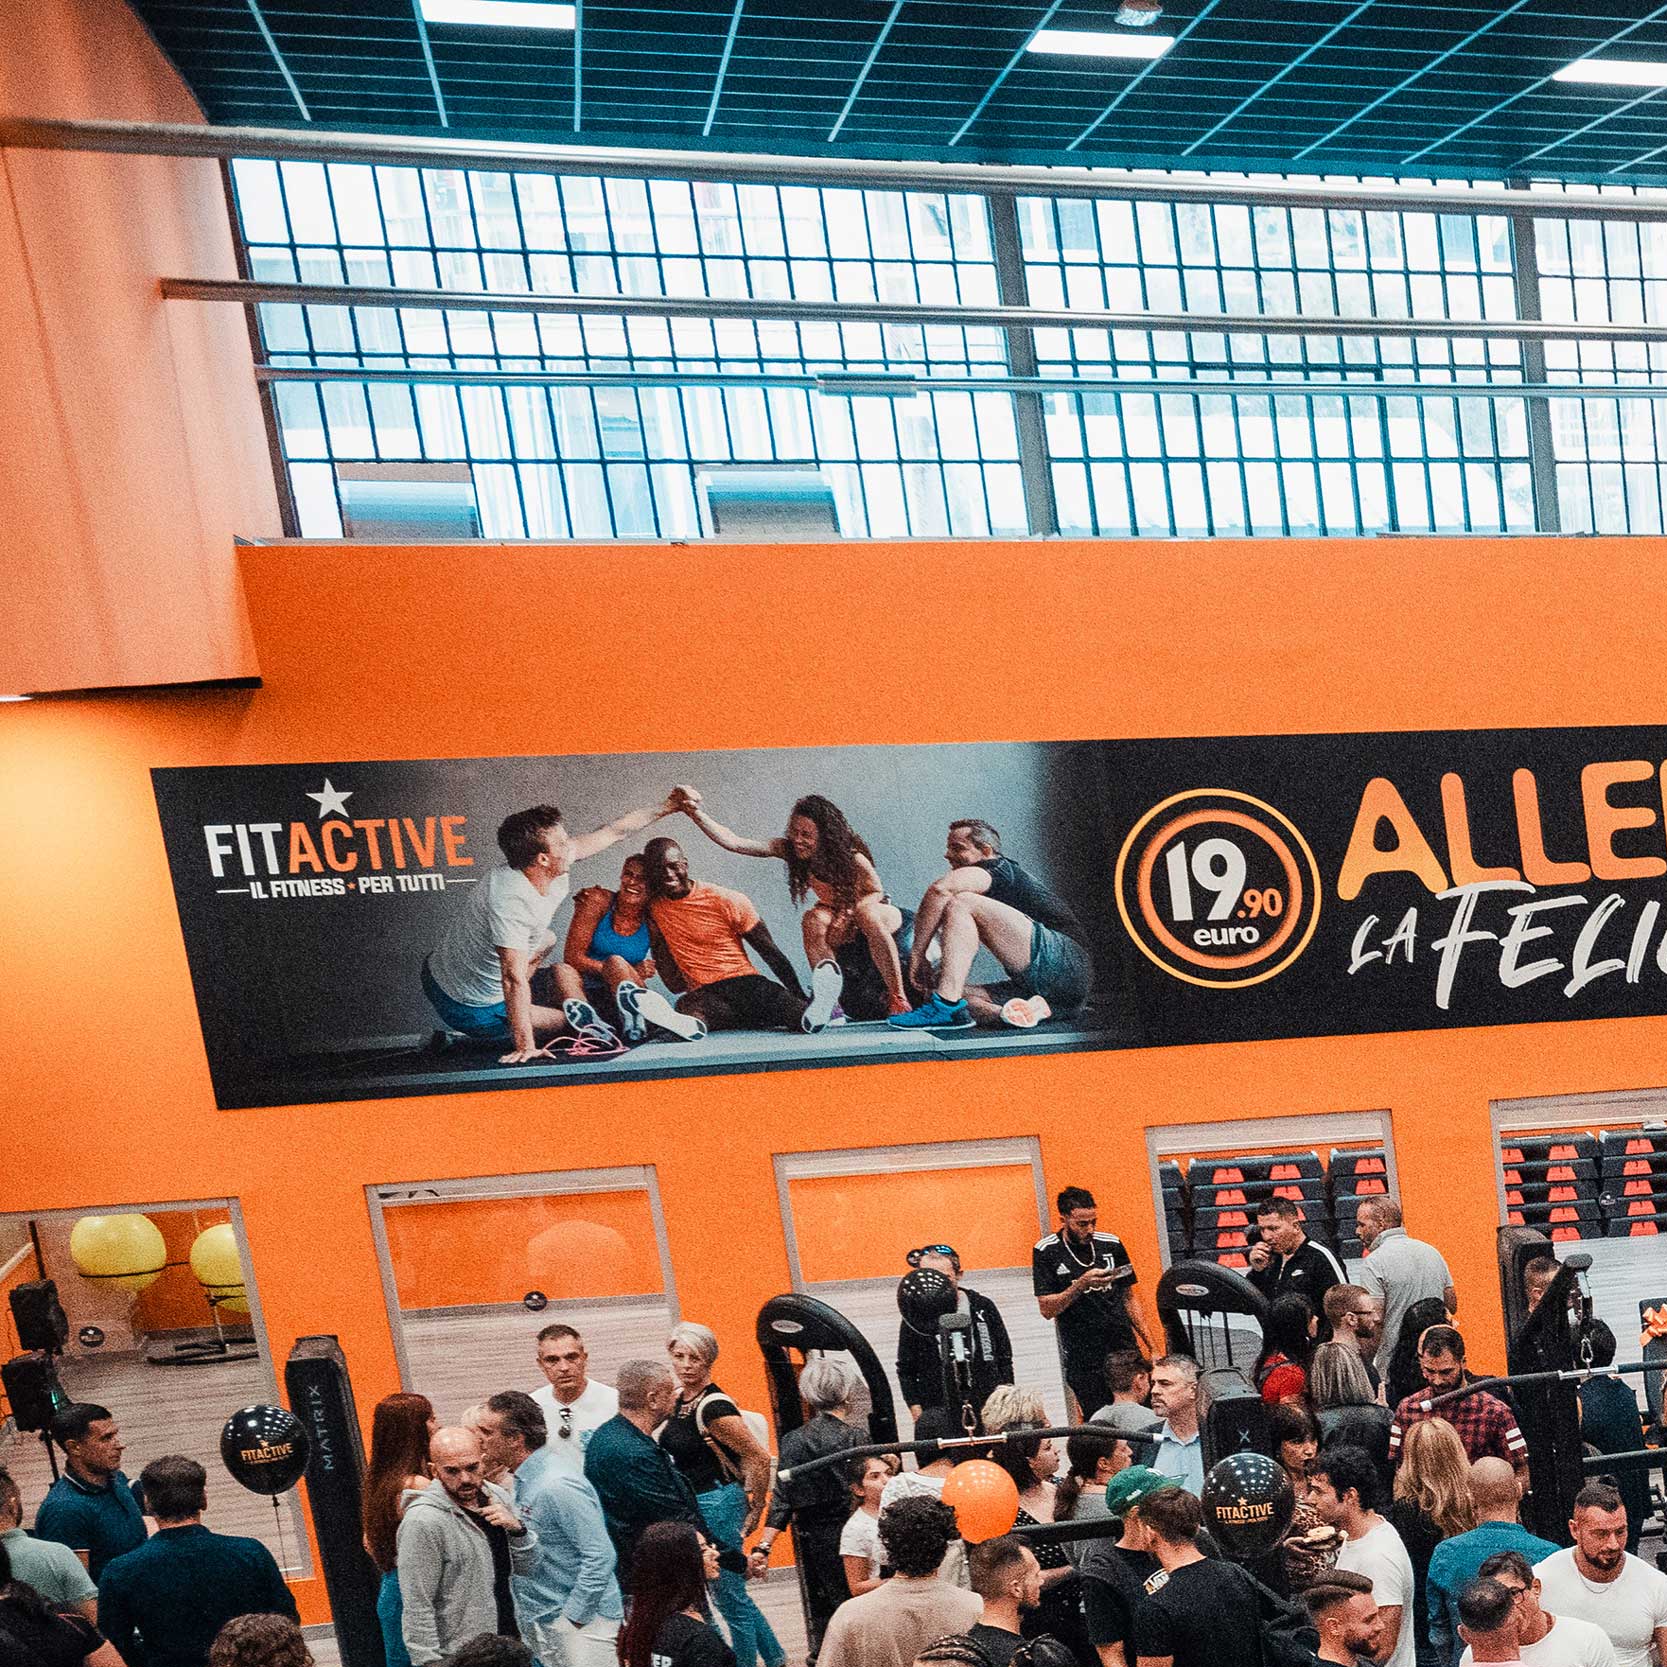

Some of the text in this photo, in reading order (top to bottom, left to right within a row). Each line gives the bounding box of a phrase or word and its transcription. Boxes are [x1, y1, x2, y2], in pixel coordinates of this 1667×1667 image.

[204, 815, 474, 877] FITACTIVE
[251, 873, 445, 899] IL FITNESS PER TUTTI
[1193, 920, 1259, 948] euro
[1348, 905, 1417, 974] LA
[308, 1385, 334, 1470] MATRIX
[240, 1443, 293, 1462] FITACTIVE
[1216, 1503, 1275, 1520] FITACTIVE
